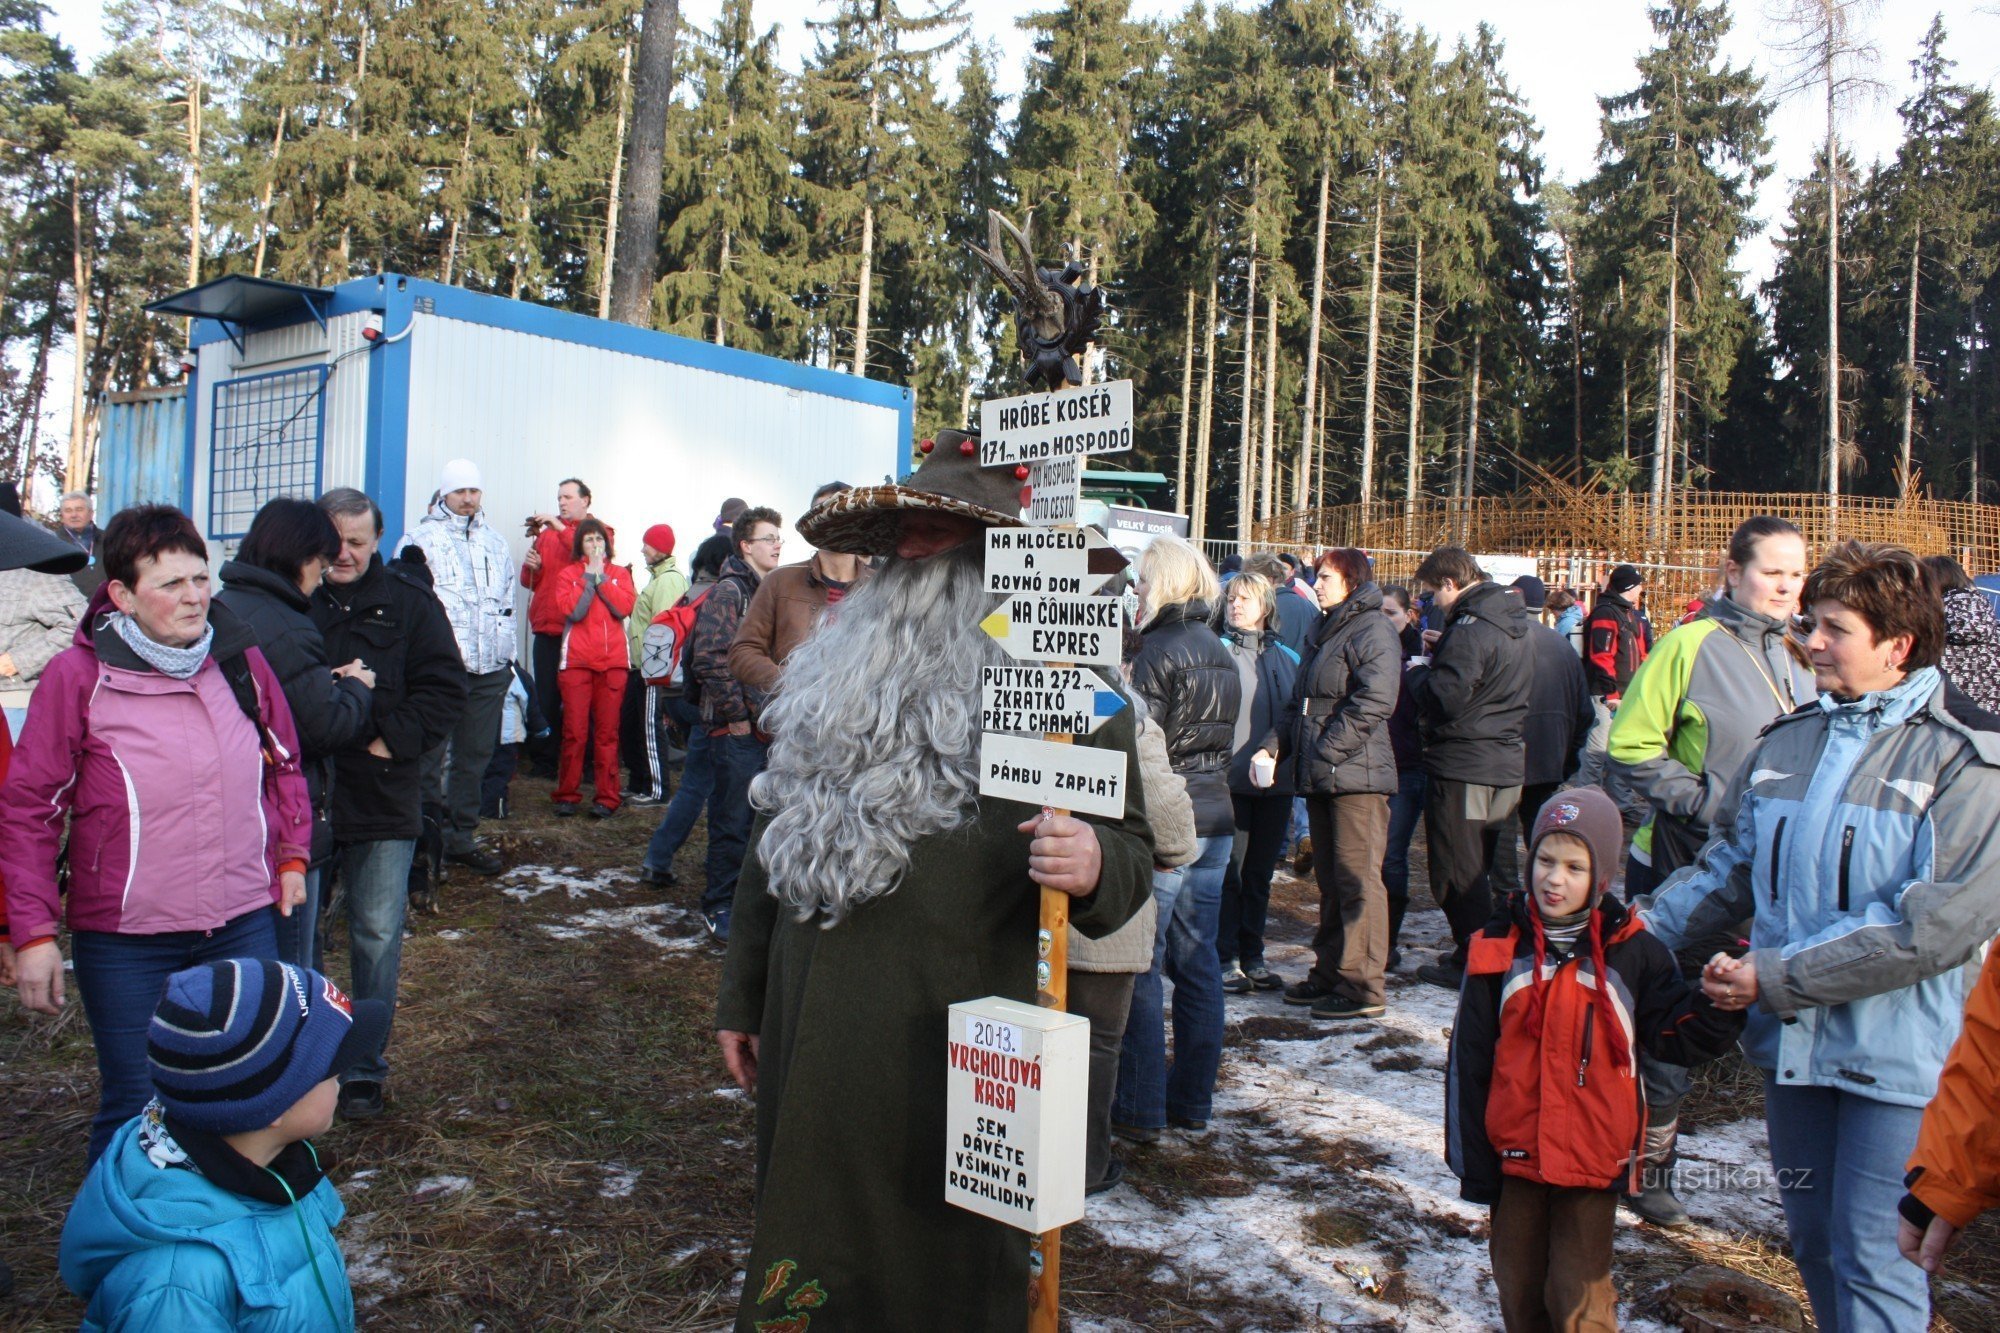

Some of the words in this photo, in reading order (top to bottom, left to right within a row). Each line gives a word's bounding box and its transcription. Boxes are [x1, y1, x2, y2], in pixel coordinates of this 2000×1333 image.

[999, 395, 1050, 431] HRÔBÉ
[1056, 387, 1112, 423] KOSÉŘ
[1020, 441, 1050, 460] NAD
[1053, 421, 1130, 455] HOSPODÓ
[1032, 465, 1042, 489] DO
[1032, 491, 1049, 520] TÓTO
[1050, 487, 1075, 519] CESTÓ
[991, 533, 1010, 549] NA
[1017, 528, 1086, 549] HLOČELÔ
[1116, 519, 1145, 531] VELKÝ
[1024, 553, 1034, 569] A
[991, 571, 1042, 591] ROVNÓ
[1048, 577, 1080, 594] DOM
[1012, 600, 1032, 624] NA
[1037, 596, 1118, 628] ČÔNINSKÉ
[1032, 630, 1100, 657] EXPRES
[983, 667, 1044, 689] PUTYKA
[993, 688, 1065, 711] ZKRATKÓ
[983, 708, 1022, 731] PŘEZ
[1029, 710, 1090, 734] CHAMČI
[990, 759, 1042, 785] PÁMBU
[1054, 772, 1118, 798] ZAPLAŤ
[974, 1021, 1016, 1053] 2013.
[948, 1041, 1042, 1092] VRCHOLOVÁ
[974, 1076, 1016, 1114] KASA
[976, 1116, 1007, 1139] SEM
[963, 1133, 1025, 1167] DÁVÉTE
[955, 1151, 1012, 1183] VŠIMNY
[1017, 1172, 1027, 1189] A
[949, 1170, 1035, 1212] ROZHLIDNY
